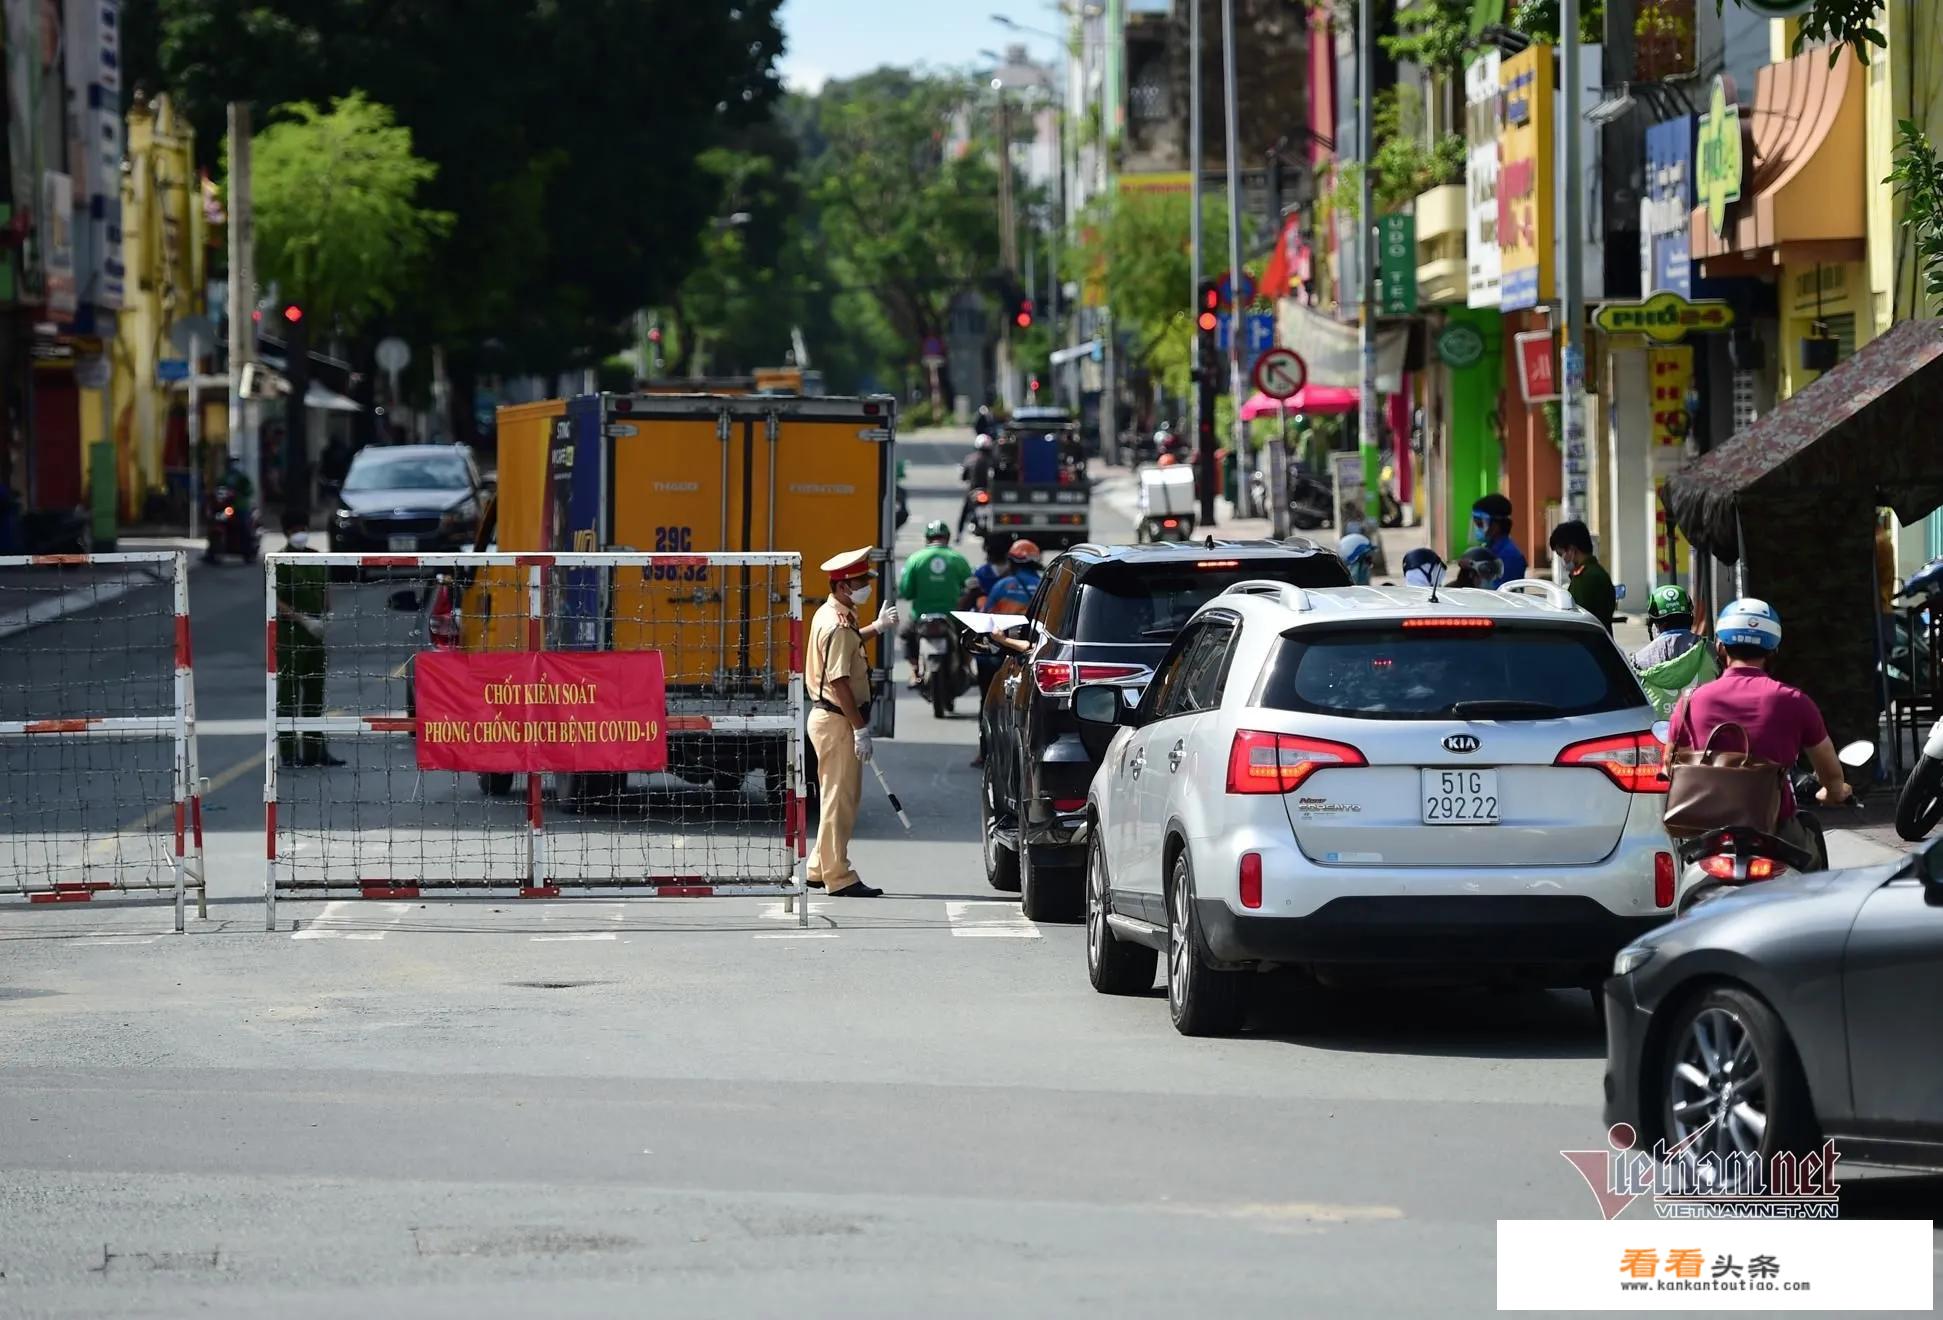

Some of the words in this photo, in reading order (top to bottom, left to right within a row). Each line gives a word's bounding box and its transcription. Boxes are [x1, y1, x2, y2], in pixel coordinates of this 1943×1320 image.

[656, 526, 691, 552] 29C
[484, 674, 521, 704] CHỐT
[524, 672, 562, 704] KIỂM
[562, 677, 596, 704] SOÁT
[424, 715, 470, 743] PHÒNG
[474, 711, 521, 743] CHỐNG
[523, 720, 556, 747] DỊCH
[560, 716, 596, 747] BỆNH
[599, 720, 658, 743] COVID-19
[1448, 737, 1476, 749] KIA
[1441, 772, 1481, 794] 51G
[1427, 796, 1499, 819] 292.22
